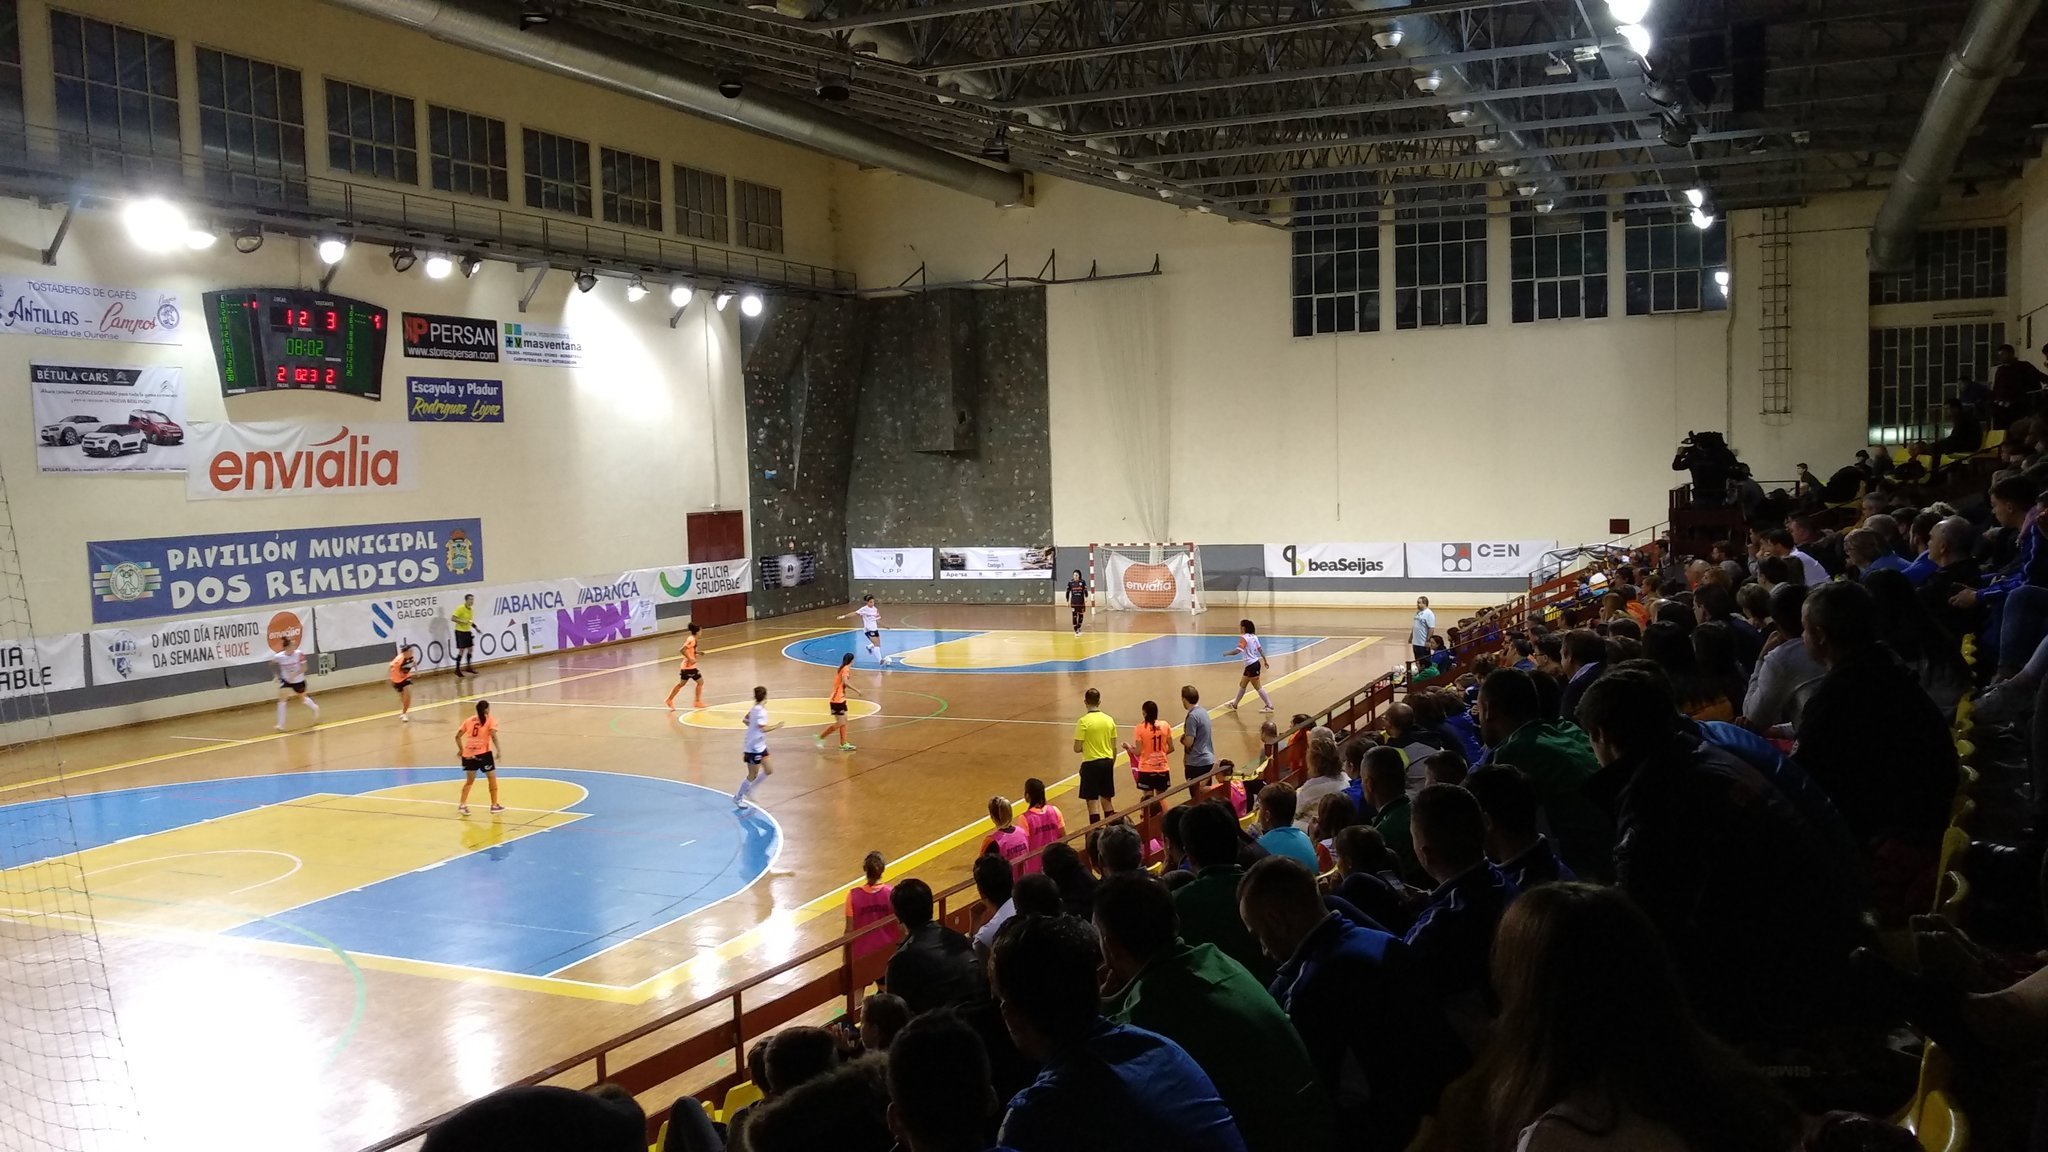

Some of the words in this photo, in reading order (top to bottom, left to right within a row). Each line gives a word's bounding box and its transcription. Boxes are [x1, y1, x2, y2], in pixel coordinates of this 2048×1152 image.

[28, 281, 90, 295] TOSTADEROS
[93, 289, 106, 298] DE
[108, 289, 136, 300] CAFÉS
[5, 296, 79, 327] ANTILLAS
[100, 302, 157, 335] Campos
[287, 309, 293, 325] 1
[299, 311, 308, 326] 2
[326, 312, 336, 329] 3
[34, 327, 68, 337] Calidad
[70, 329, 82, 338] de
[84, 331, 119, 340] Ourense
[430, 323, 496, 347] PERSAN
[286, 338, 324, 356] 08:02
[407, 346, 496, 360] www.storespersan.com
[524, 339, 582, 351] masventana
[36, 368, 77, 381] BÉTULA
[80, 372, 108, 382] CARS
[278, 366, 286, 382] 2
[326, 369, 335, 384] 2
[412, 381, 456, 397] Escayola
[458, 385, 464, 398] y
[467, 383, 498, 396] Pladur
[309, 531, 438, 558] MUNICIPAL
[1477, 544, 1520, 558] CEN
[695, 565, 729, 580] GALICIA
[1308, 558, 1384, 575] beaSeijas
[170, 574, 251, 610] DOS
[266, 556, 440, 600] REMEDIOS
[696, 577, 740, 594] SAUDABLE
[396, 596, 438, 609] DEPORTE
[397, 608, 434, 620] GALEGO
[556, 600, 632, 650] NON
[152, 634, 160, 648] O
[162, 630, 191, 647] NOSO
[194, 624, 211, 643] DÍA
[214, 622, 260, 640] FAVORITO
[152, 653, 168, 668] DA
[170, 646, 214, 666] SEMANA
[216, 641, 222, 660] É
[224, 642, 250, 658] HOXE
[472, 722, 480, 738] 6
[1152, 734, 1162, 752] 11
